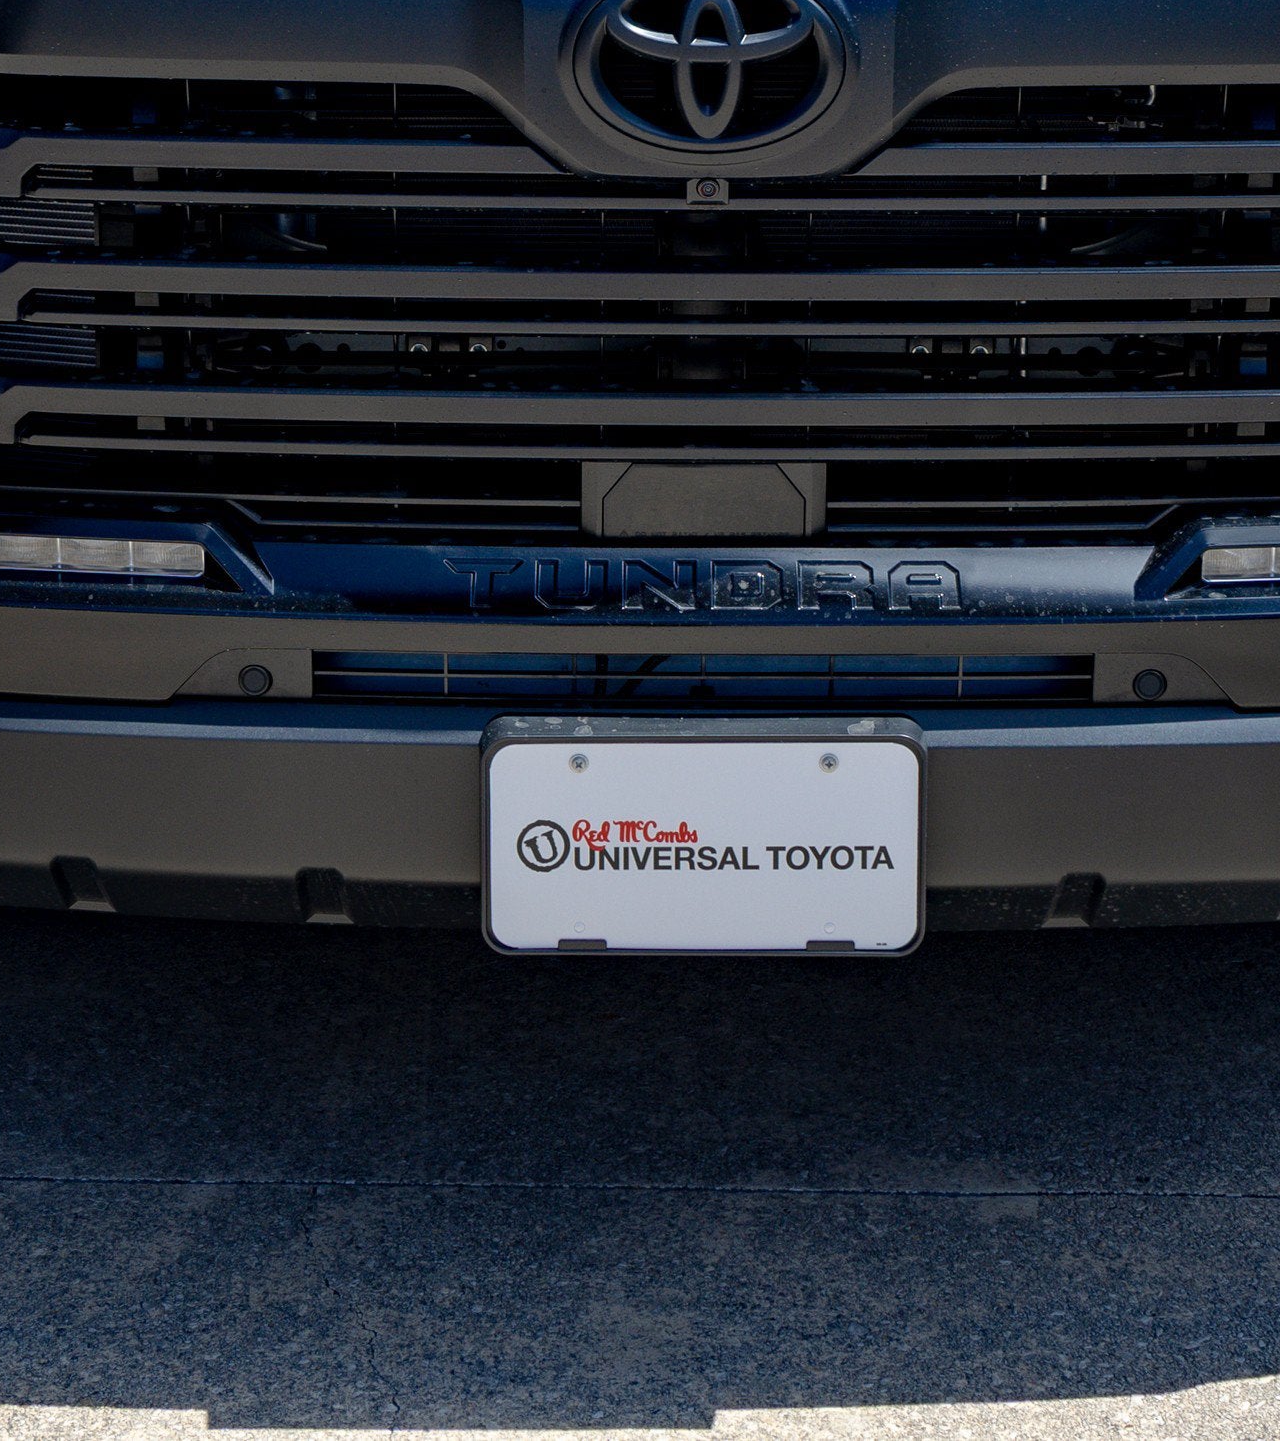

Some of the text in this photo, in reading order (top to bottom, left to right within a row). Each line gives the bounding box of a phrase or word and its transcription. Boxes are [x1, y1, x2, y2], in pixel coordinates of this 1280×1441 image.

[443, 558, 962, 611] TUNDRA
[572, 819, 698, 851] Red McCombs
[574, 845, 895, 870] UNIVERSAL TOYOTA
